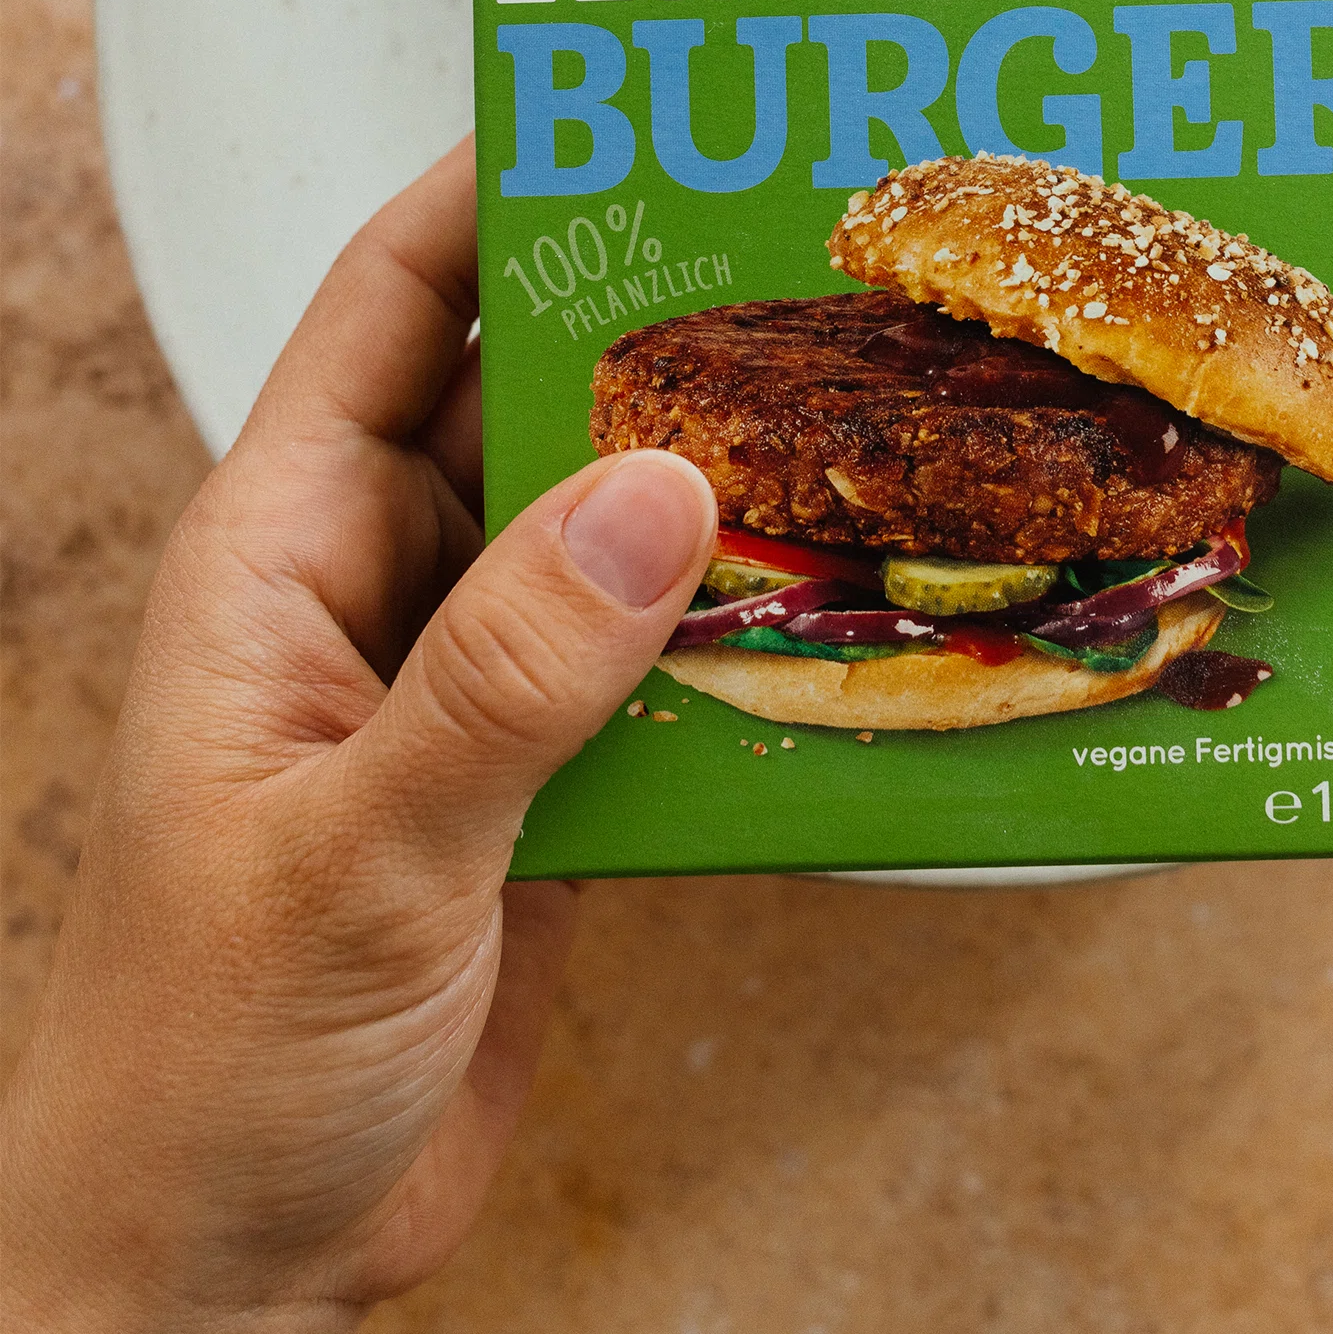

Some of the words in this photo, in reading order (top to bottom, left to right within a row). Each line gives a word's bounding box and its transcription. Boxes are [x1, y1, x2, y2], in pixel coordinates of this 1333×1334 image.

[503, 200, 663, 317] 100%
[560, 253, 733, 341] PFLANZLICH
[1072, 742, 1186, 771] vegane
